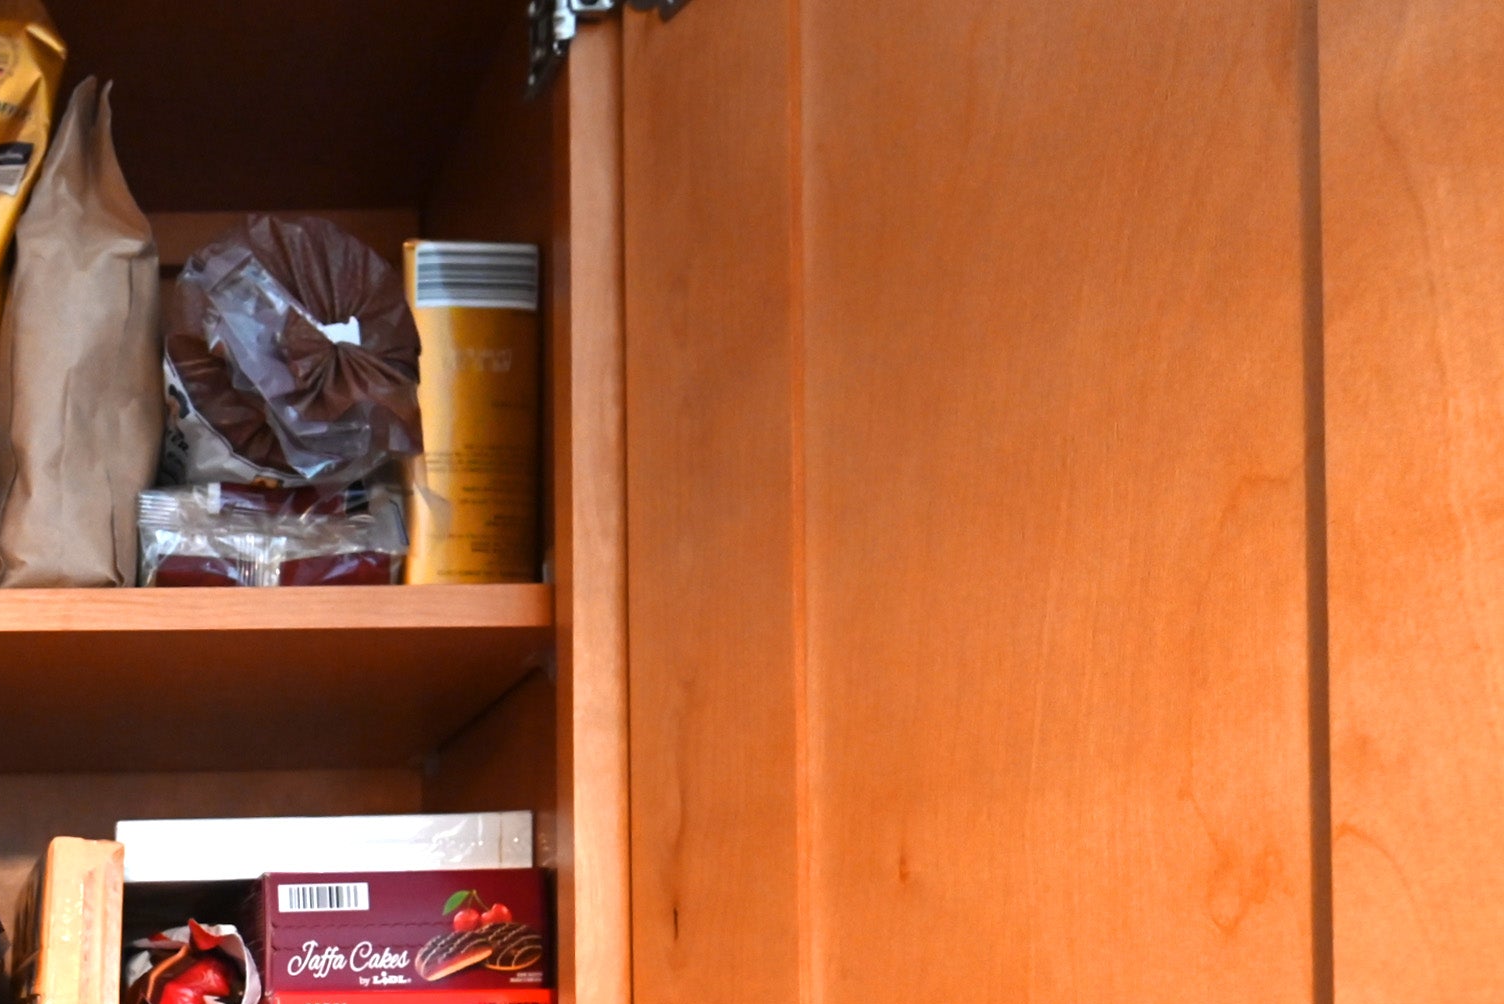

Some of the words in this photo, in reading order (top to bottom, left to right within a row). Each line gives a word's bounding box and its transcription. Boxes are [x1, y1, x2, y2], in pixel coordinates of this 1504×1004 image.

[287, 939, 347, 978] Jaffa
[349, 940, 410, 972] Cakes
[359, 976, 371, 986] by
